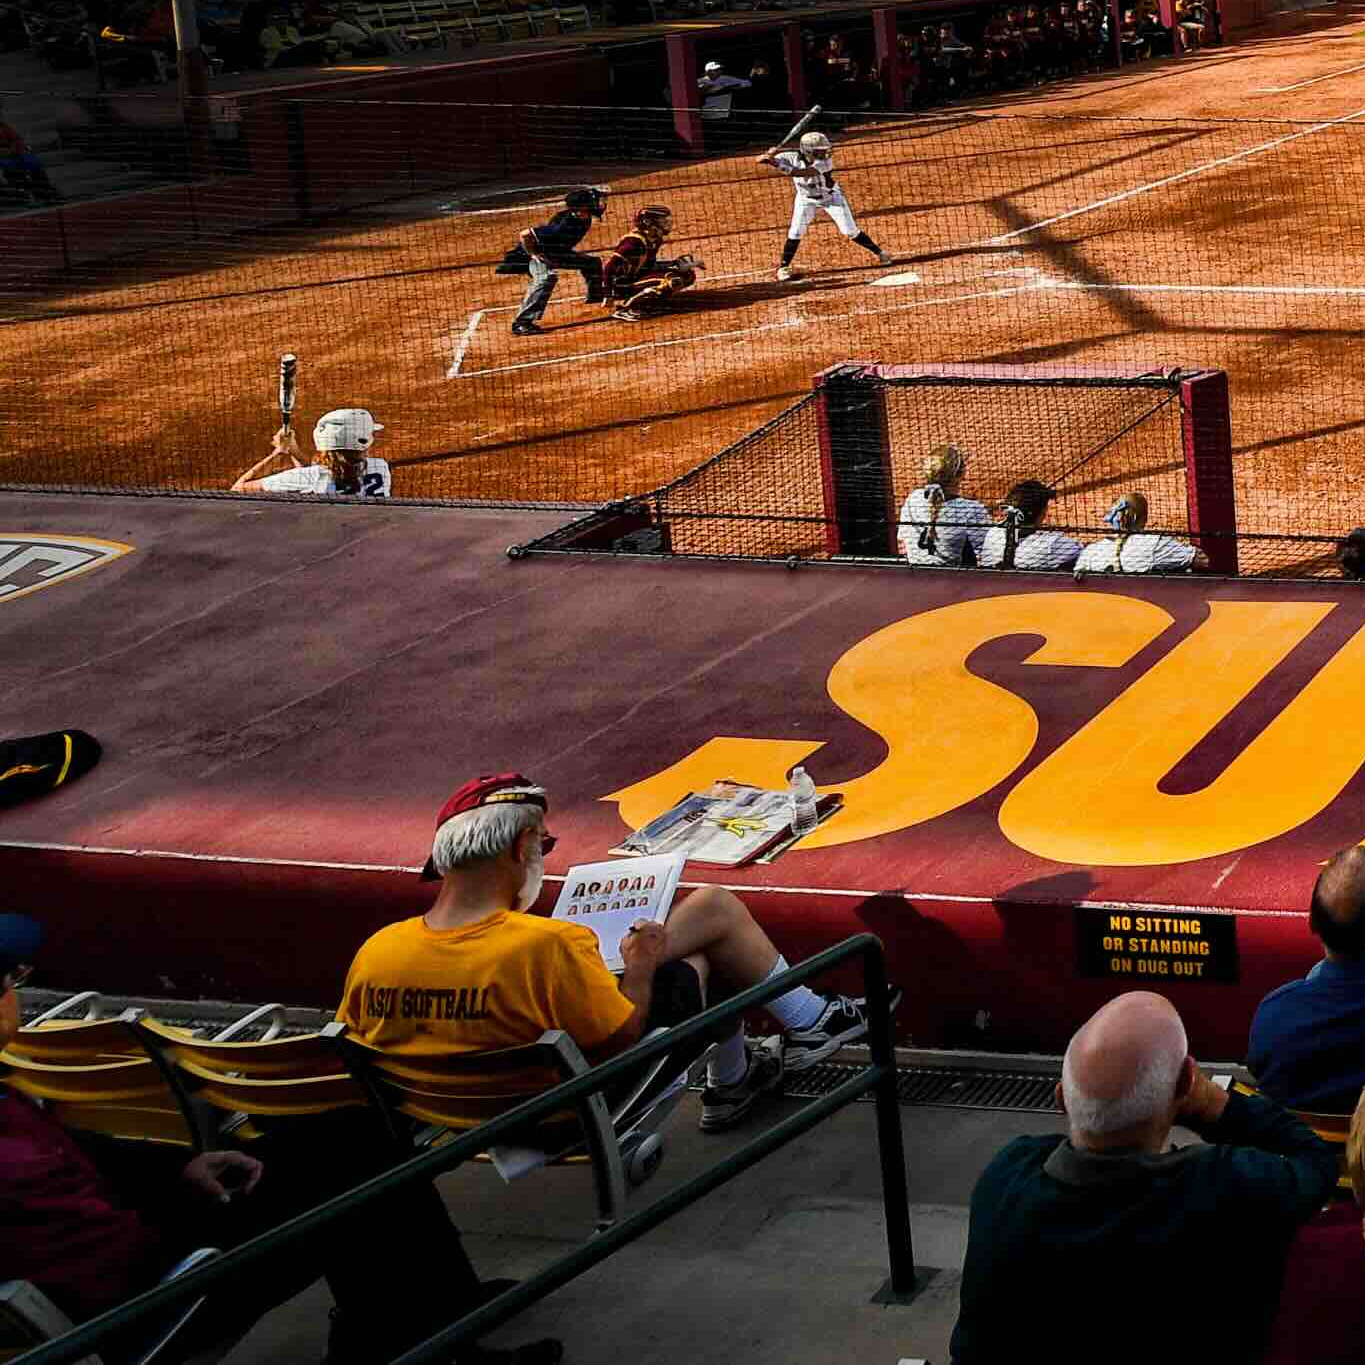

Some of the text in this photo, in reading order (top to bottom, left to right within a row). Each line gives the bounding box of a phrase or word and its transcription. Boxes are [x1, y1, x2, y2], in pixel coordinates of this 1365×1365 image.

[1109, 916, 1201, 934] NO SITTING
[1103, 936, 1210, 955] OR STANDING
[1110, 958, 1204, 976] ON DUG OUT
[365, 986, 490, 1019] ASU SOFTBALL
